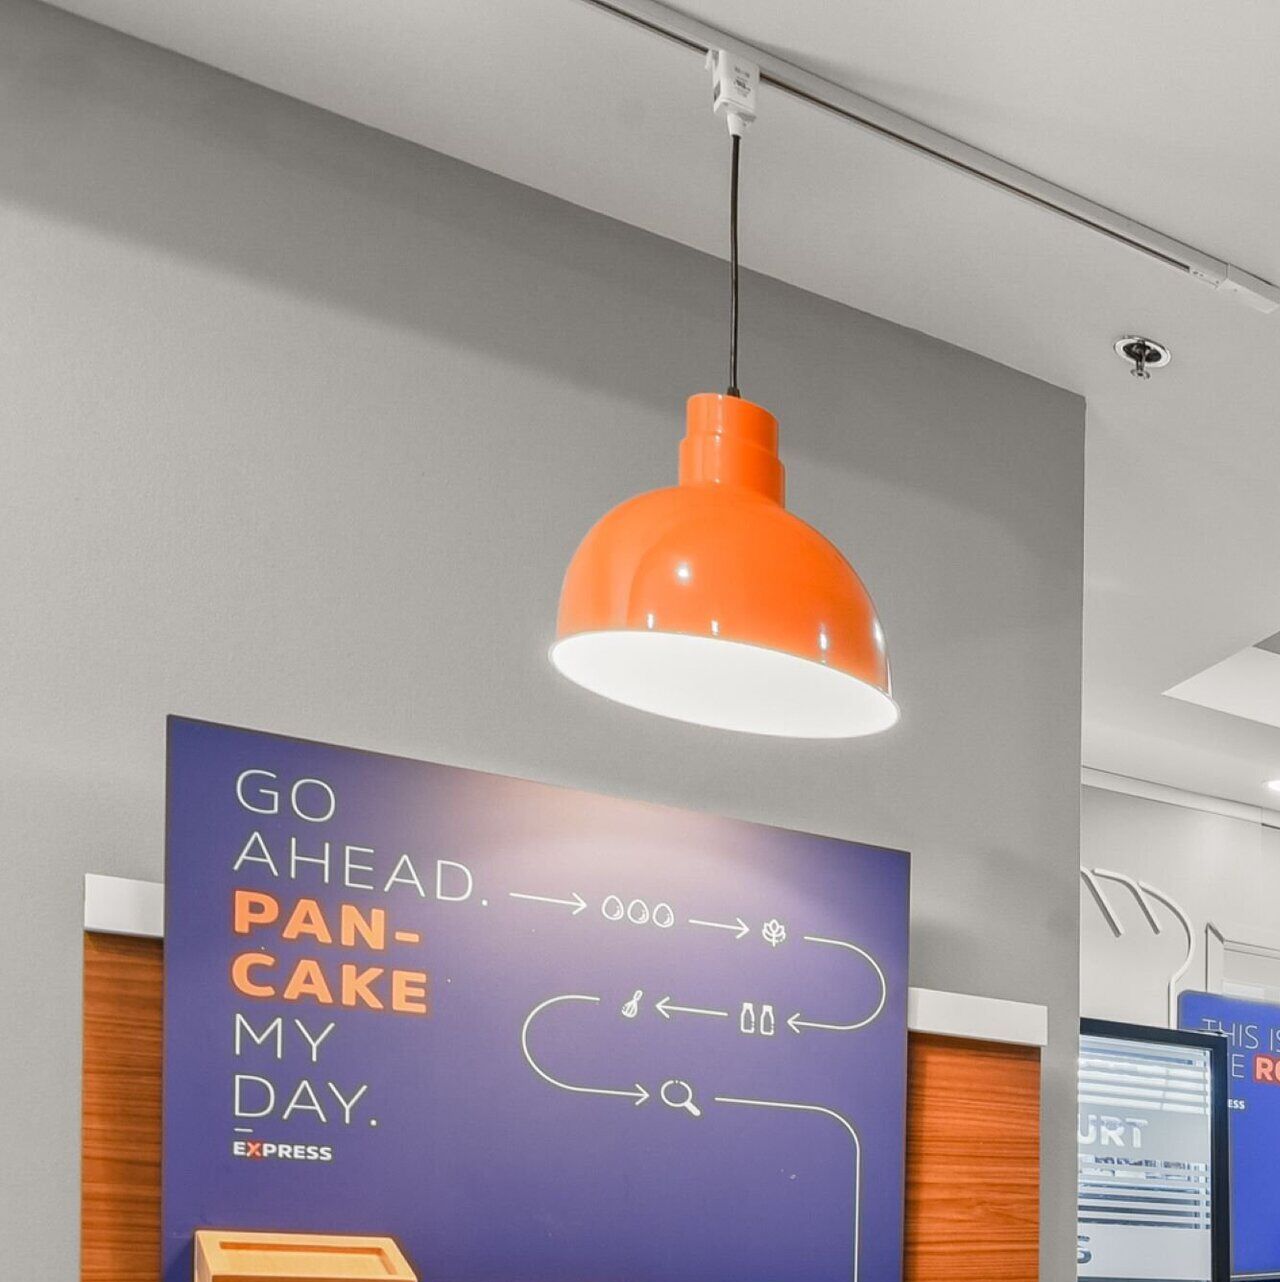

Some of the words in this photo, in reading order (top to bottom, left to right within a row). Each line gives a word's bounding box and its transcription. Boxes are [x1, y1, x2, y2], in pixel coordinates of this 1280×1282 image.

[236, 769, 336, 823] GO
[233, 831, 489, 907] AHEAD.
[232, 890, 421, 950] PAN-
[231, 952, 428, 1014] CAKE
[234, 1013, 335, 1063] MY
[233, 1073, 378, 1127] DAY.
[232, 1140, 333, 1161] EXPRESS
